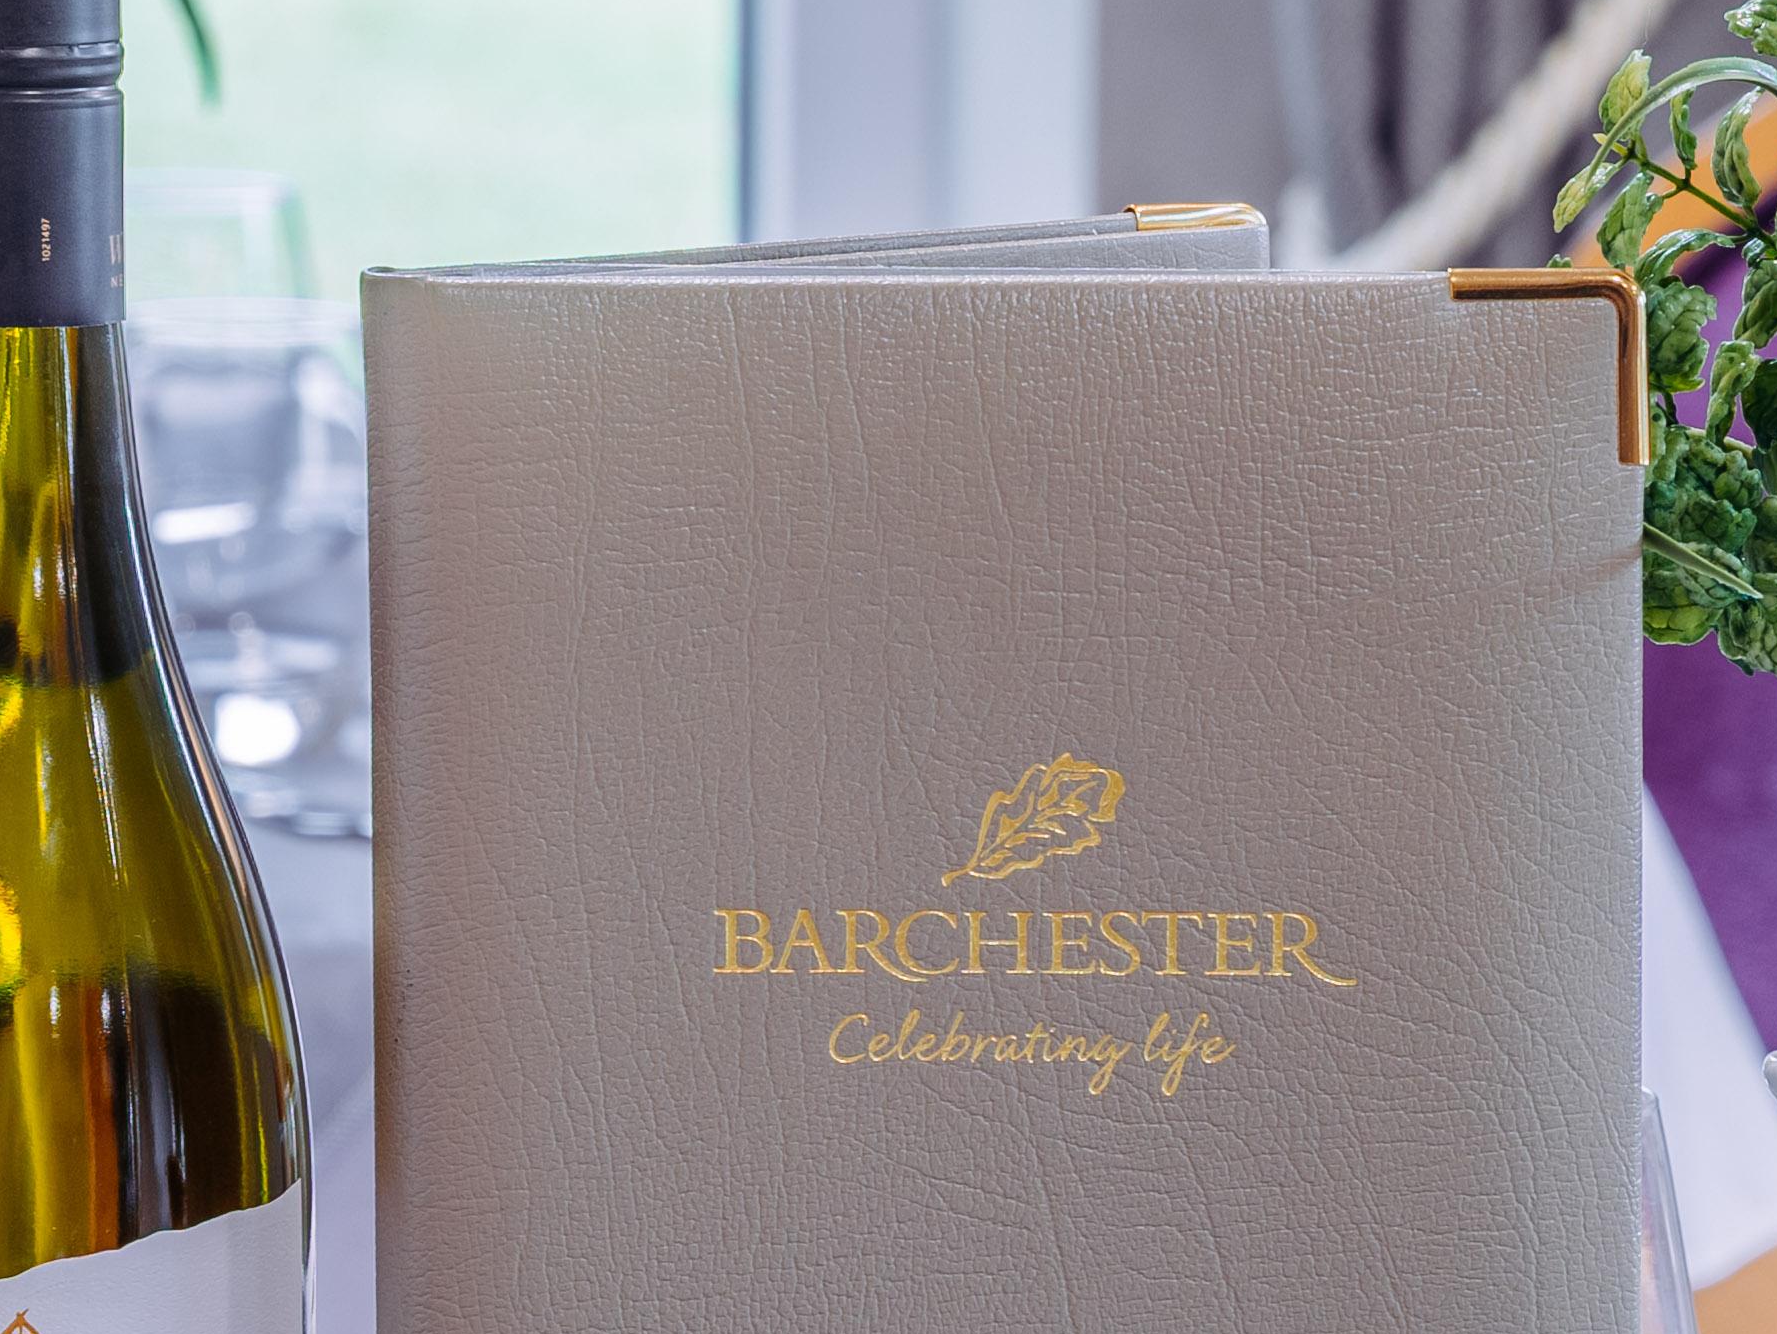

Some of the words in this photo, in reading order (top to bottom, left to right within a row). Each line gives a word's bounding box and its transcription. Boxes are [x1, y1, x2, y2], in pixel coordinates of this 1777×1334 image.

[40, 218, 52, 262] 1021497
[713, 908, 1357, 987] BARCHESTER
[828, 1009, 1128, 1096] Celebrating
[1143, 1012, 1236, 1097] life
